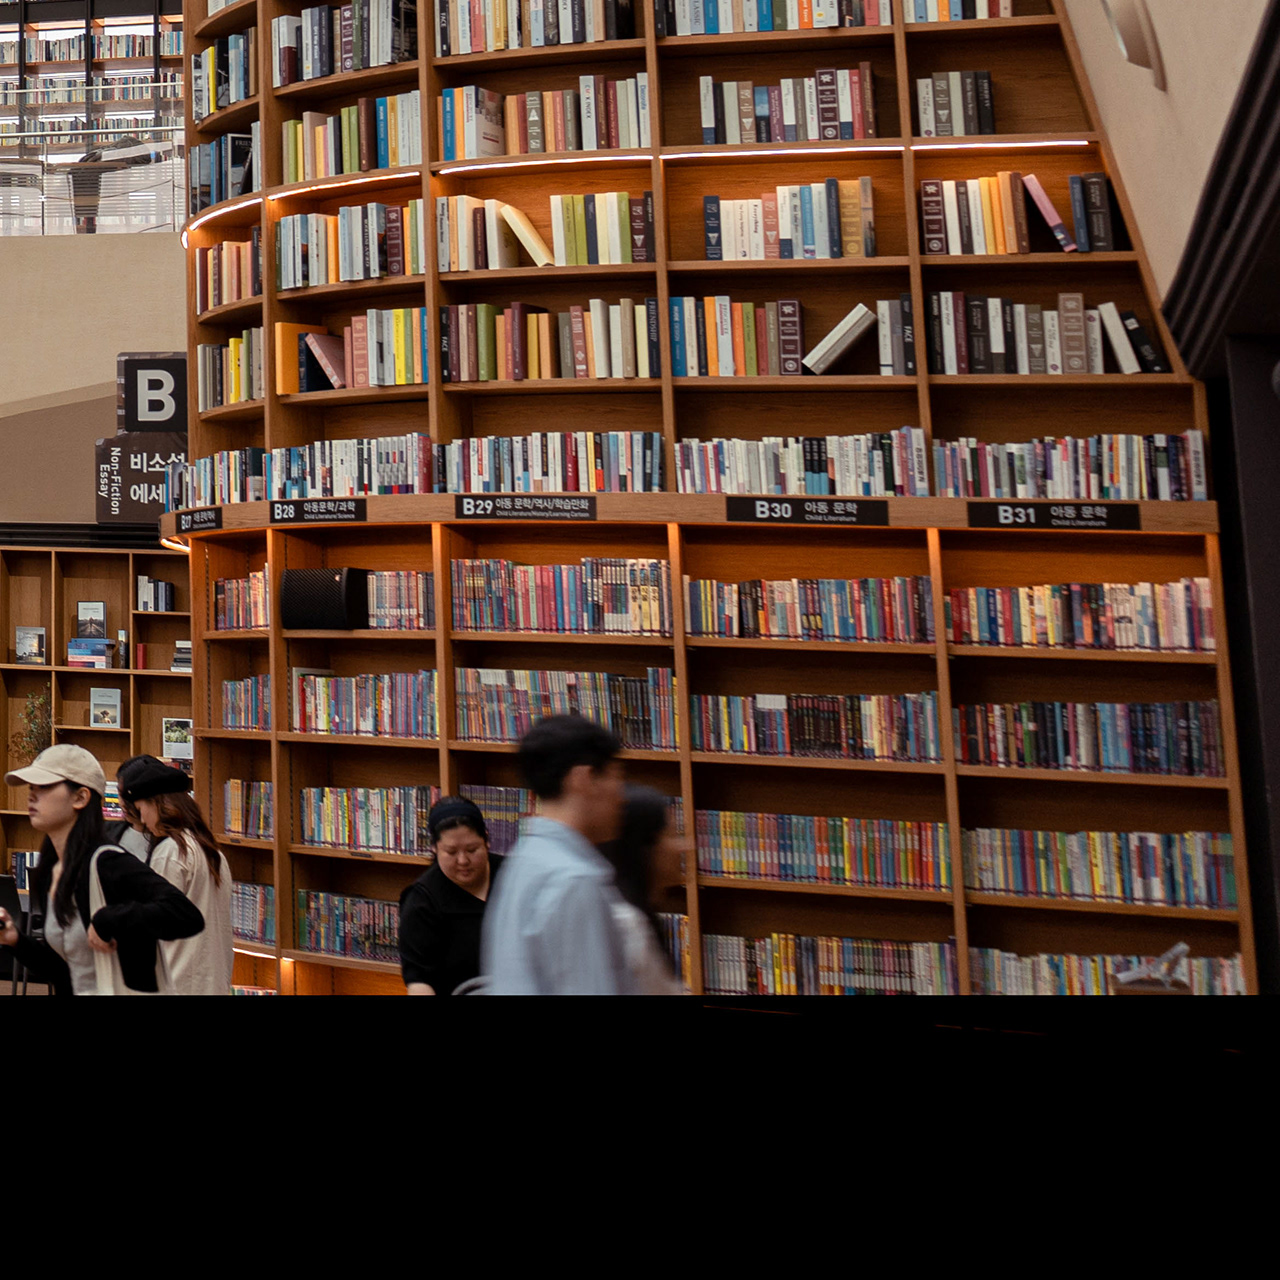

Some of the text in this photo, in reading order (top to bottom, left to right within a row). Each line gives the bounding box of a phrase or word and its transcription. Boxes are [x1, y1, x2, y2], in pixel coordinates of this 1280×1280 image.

[137, 369, 176, 421] B
[98, 464, 111, 498] Essay
[110, 447, 122, 516] Non-Fiction
[274, 503, 295, 520] B28
[463, 498, 494, 515] B29
[755, 500, 792, 518] B30
[998, 505, 1036, 524] B31
